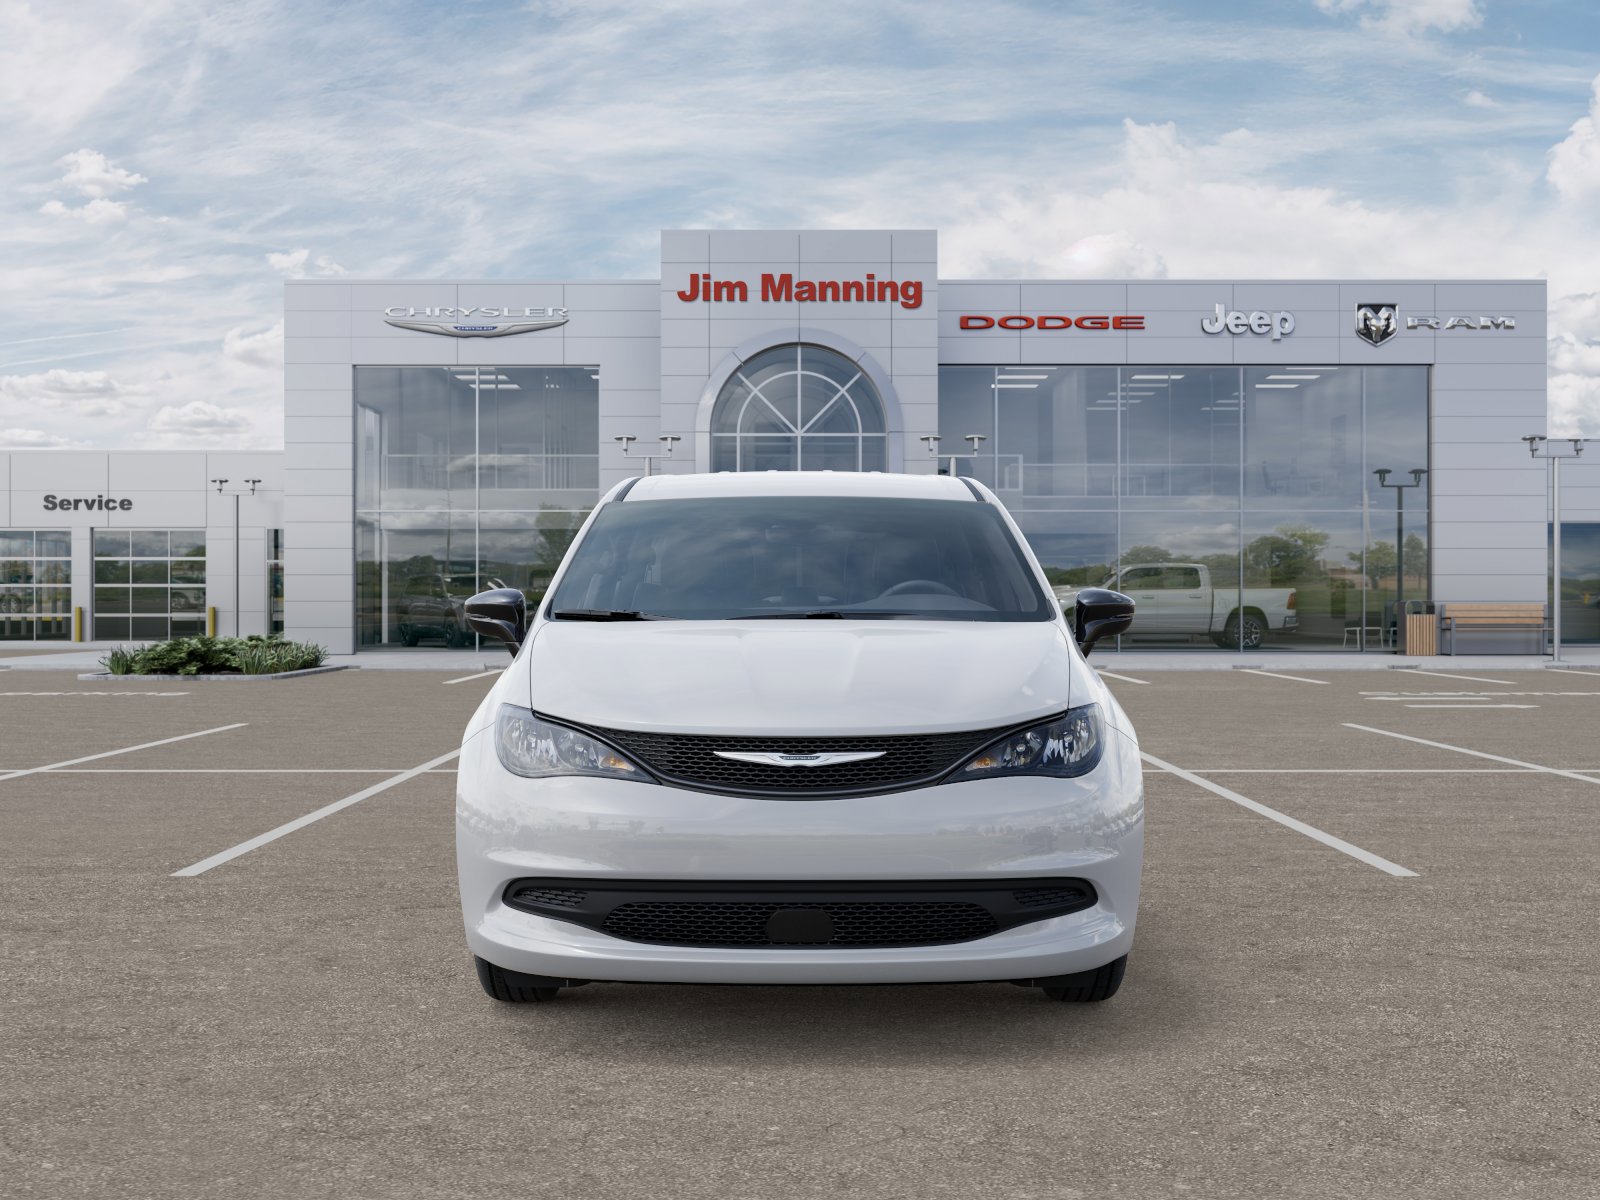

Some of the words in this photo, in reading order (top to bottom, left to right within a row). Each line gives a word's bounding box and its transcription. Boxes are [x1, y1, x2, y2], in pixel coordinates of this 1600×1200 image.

[677, 273, 748, 302] Jim
[760, 273, 923, 309] Manning
[384, 306, 569, 317] CHRYSLER
[959, 315, 1146, 330] DODGE
[1201, 303, 1295, 341] Jeep
[1406, 316, 1516, 330] RAM
[43, 494, 133, 511] Service
